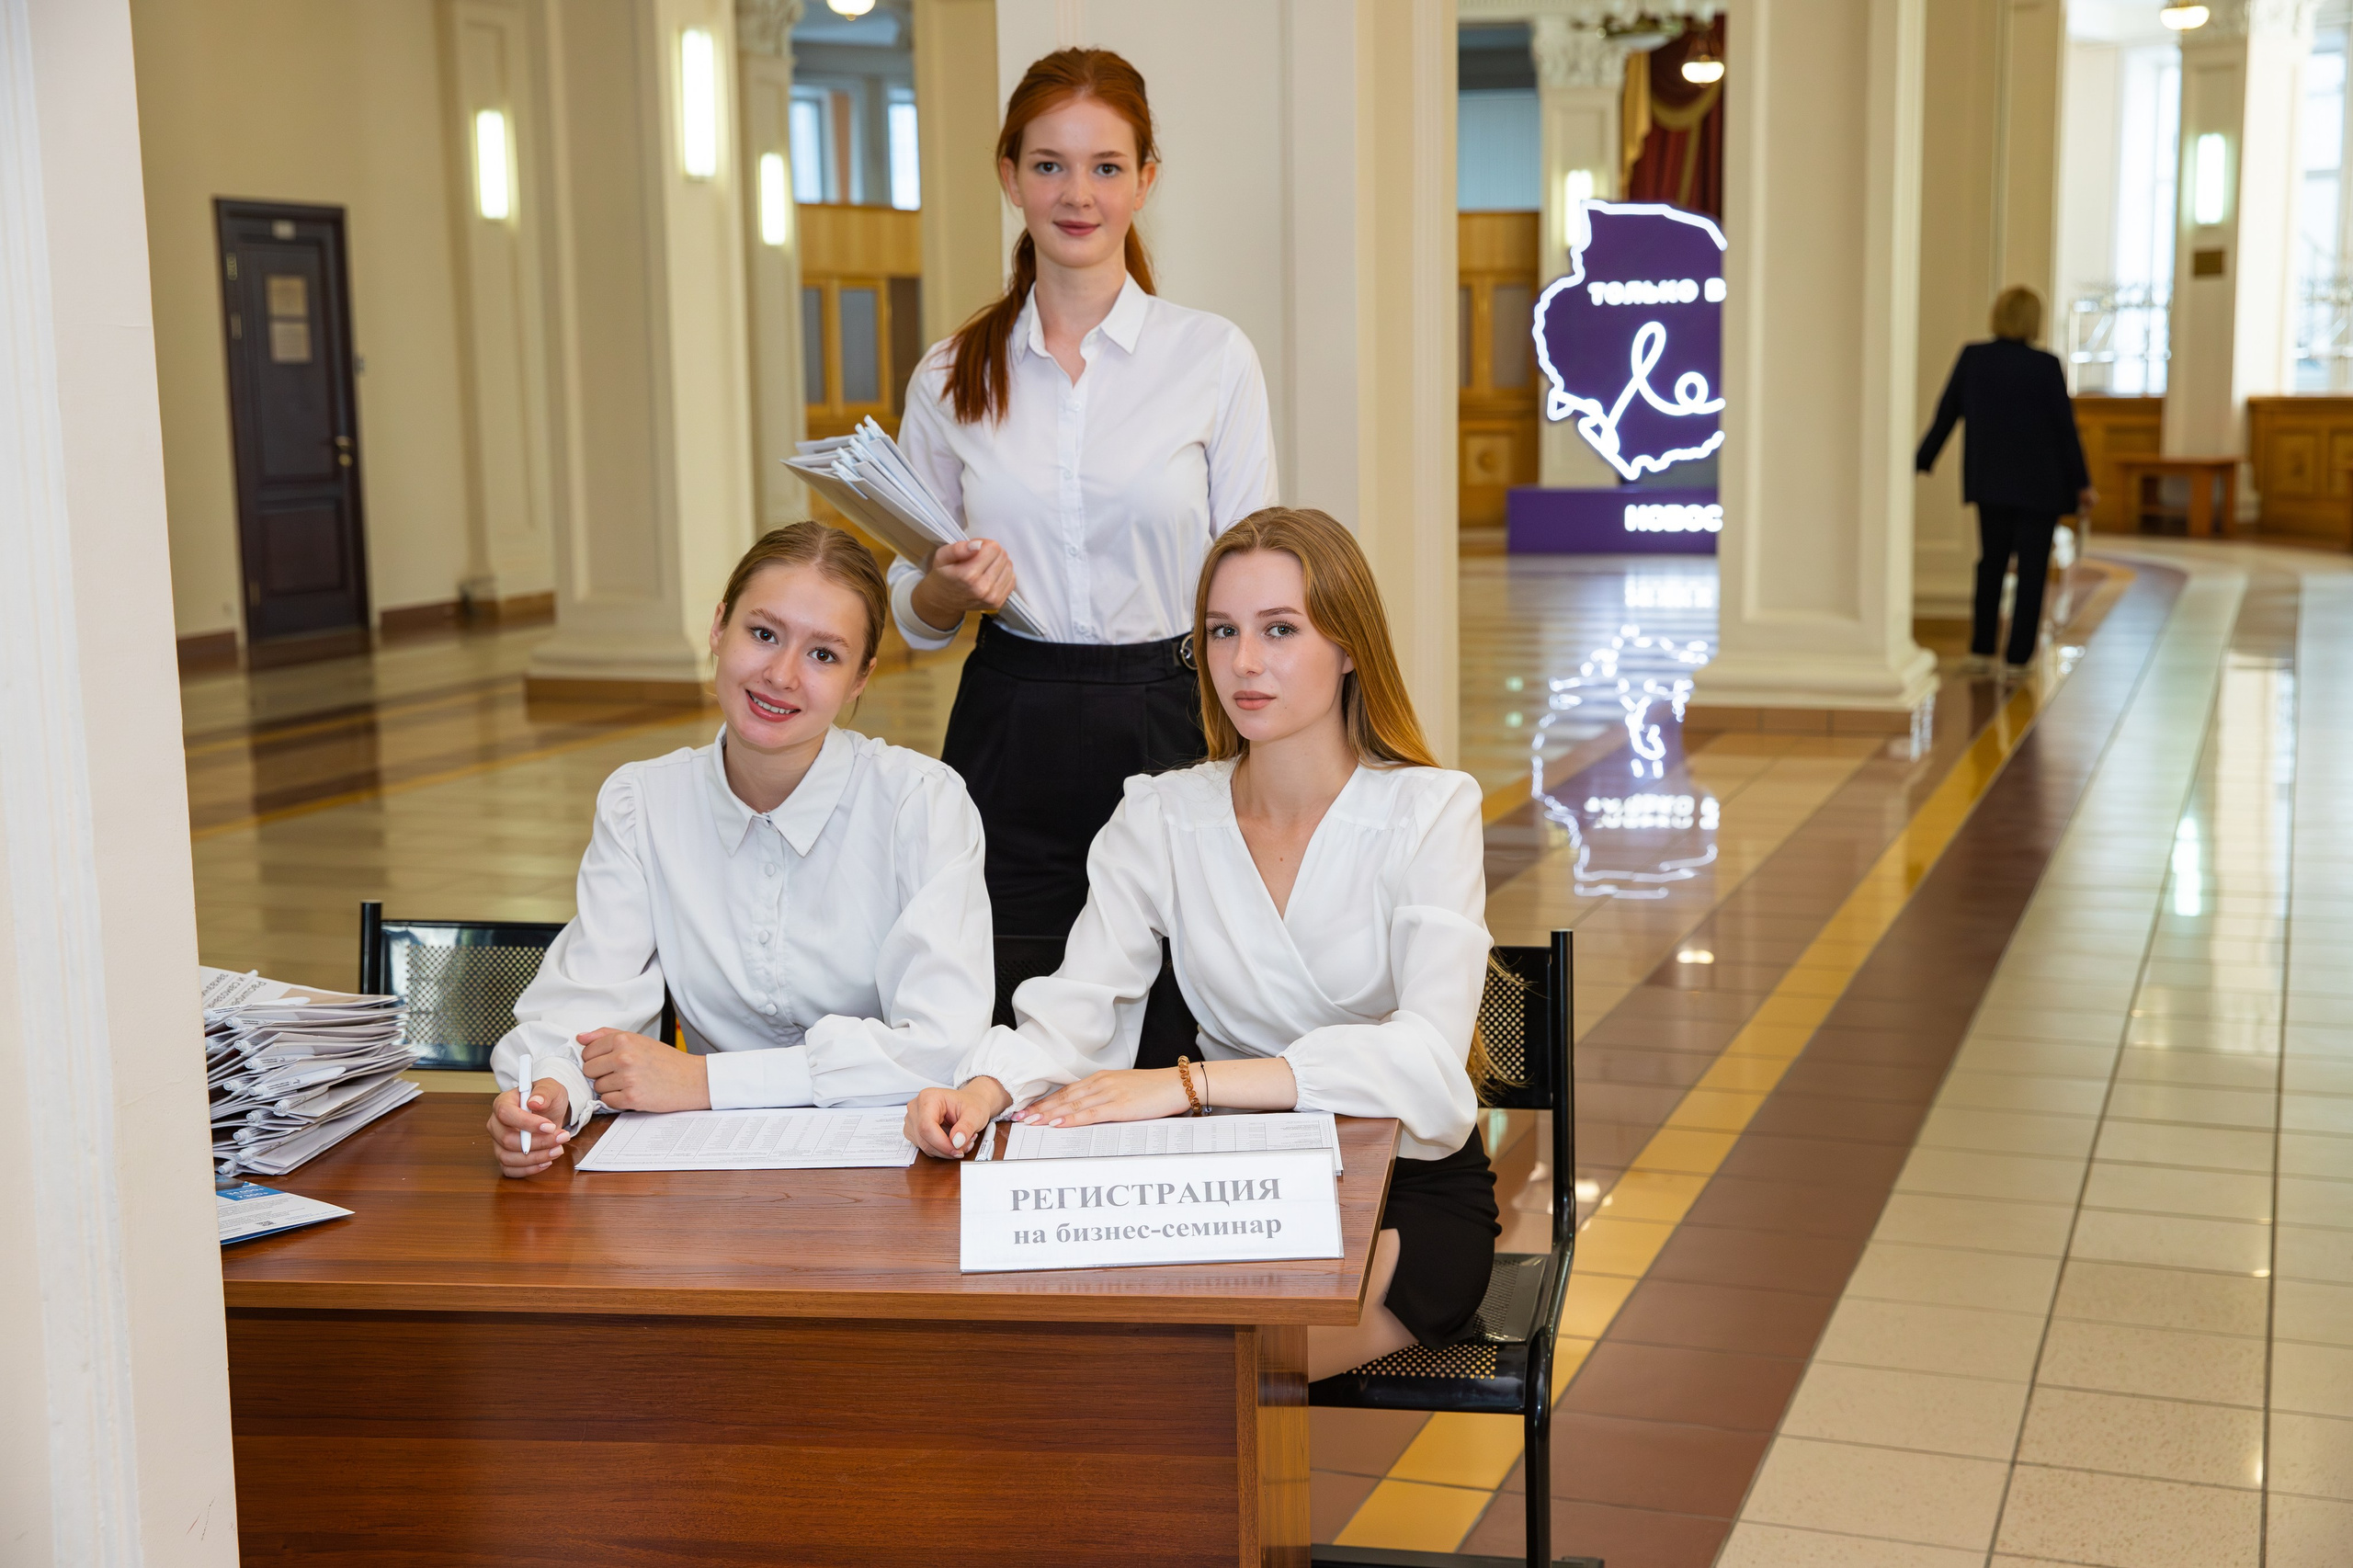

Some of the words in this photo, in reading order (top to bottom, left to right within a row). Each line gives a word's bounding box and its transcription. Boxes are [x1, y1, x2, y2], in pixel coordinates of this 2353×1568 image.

[1624, 504, 1724, 532] НОВОС
[1010, 1177, 1281, 1211] РЕГИСТРАЦИЯ
[1013, 1229, 1047, 1245] на
[1056, 1218, 1282, 1244] бизнес-семинар
